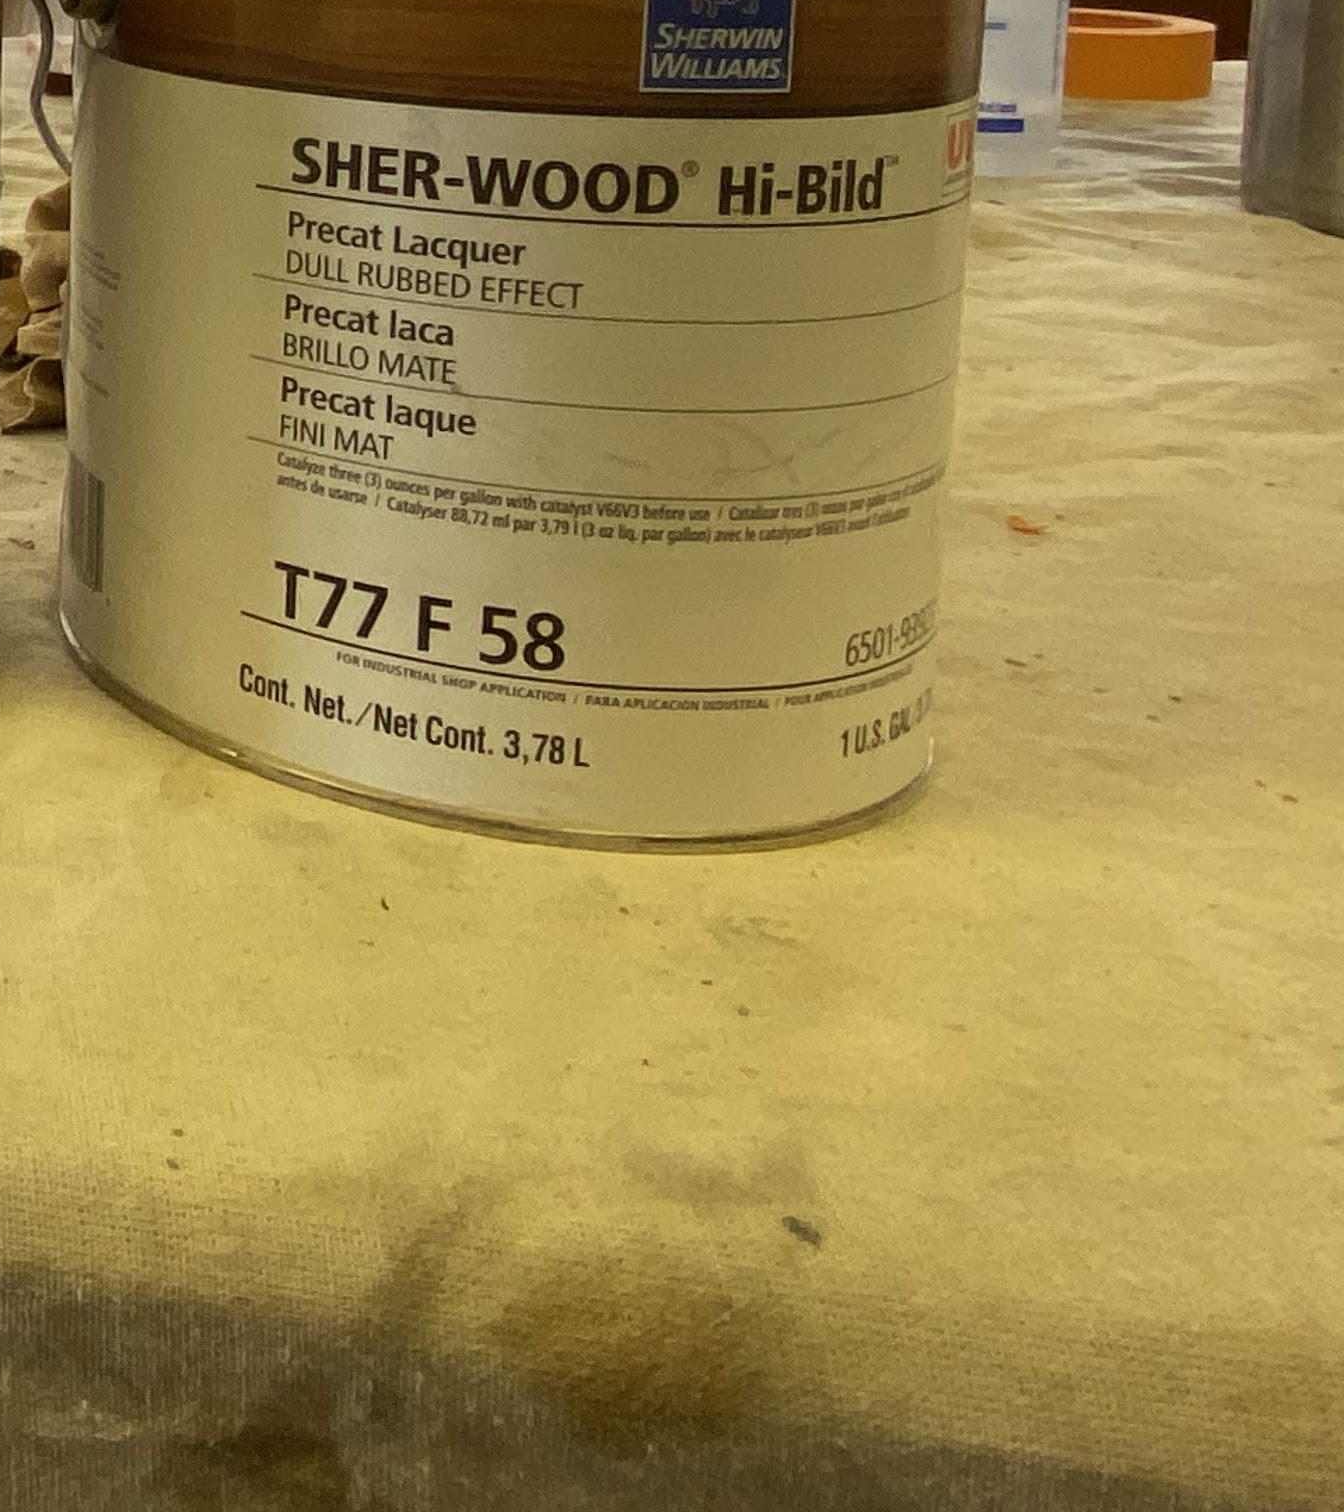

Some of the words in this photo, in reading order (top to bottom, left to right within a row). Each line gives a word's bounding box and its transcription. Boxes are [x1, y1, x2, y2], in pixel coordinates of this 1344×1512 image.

[653, 23, 784, 49] SHERWIN
[651, 52, 783, 79] WILLIAMS
[288, 210, 383, 251] Precat
[393, 226, 527, 269] Lacquer
[286, 249, 349, 284] DULL
[358, 261, 471, 299] RUBBED
[481, 276, 584, 309] EFFECT
[284, 293, 379, 336] Precat
[389, 309, 454, 347] laca
[283, 332, 369, 371] BRILLO
[378, 350, 457, 385] MATE
[281, 375, 375, 420] Precat
[386, 394, 477, 437] laque
[279, 414, 325, 447] FINI
[334, 426, 394, 460] MAT
[365, 471, 382, 490] (3)
[385, 477, 430, 497] ounces
[434, 486, 456, 502] per
[460, 489, 502, 508] gallon
[506, 496, 536, 512] with
[540, 498, 593, 518] catalyst
[596, 501, 640, 519] V66V3
[274, 560, 388, 639] T77
[417, 595, 453, 652] F
[479, 605, 565, 671] 58
[337, 650, 360, 666] FOR
[364, 658, 437, 684] INDUSTRIAL
[442, 674, 477, 690] SHOP
[479, 681, 566, 704] APPLICATION
[240, 663, 295, 708] Cont.
[426, 716, 494, 755] Cont.
[504, 730, 565, 766] 3,78
[574, 738, 590, 767] L
